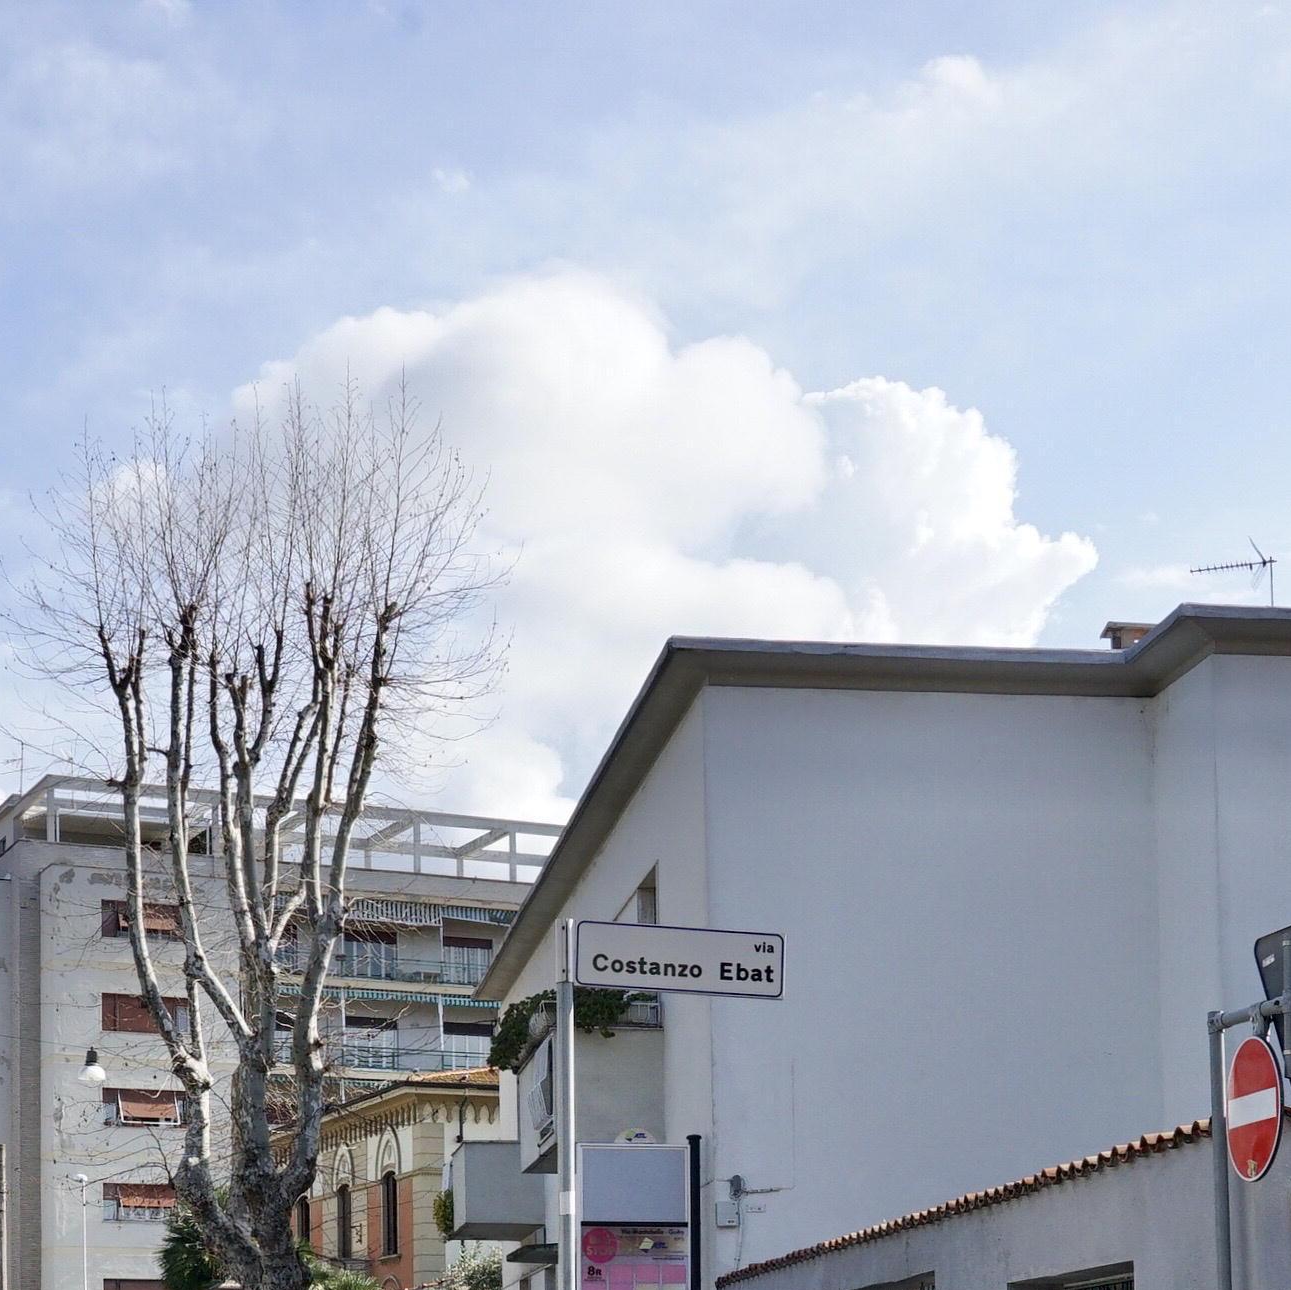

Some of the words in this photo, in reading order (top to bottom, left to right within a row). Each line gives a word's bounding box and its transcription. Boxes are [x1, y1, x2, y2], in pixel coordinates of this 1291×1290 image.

[753, 942, 775, 954] via
[592, 953, 703, 979] Costanzo
[719, 962, 775, 983] Ebat
